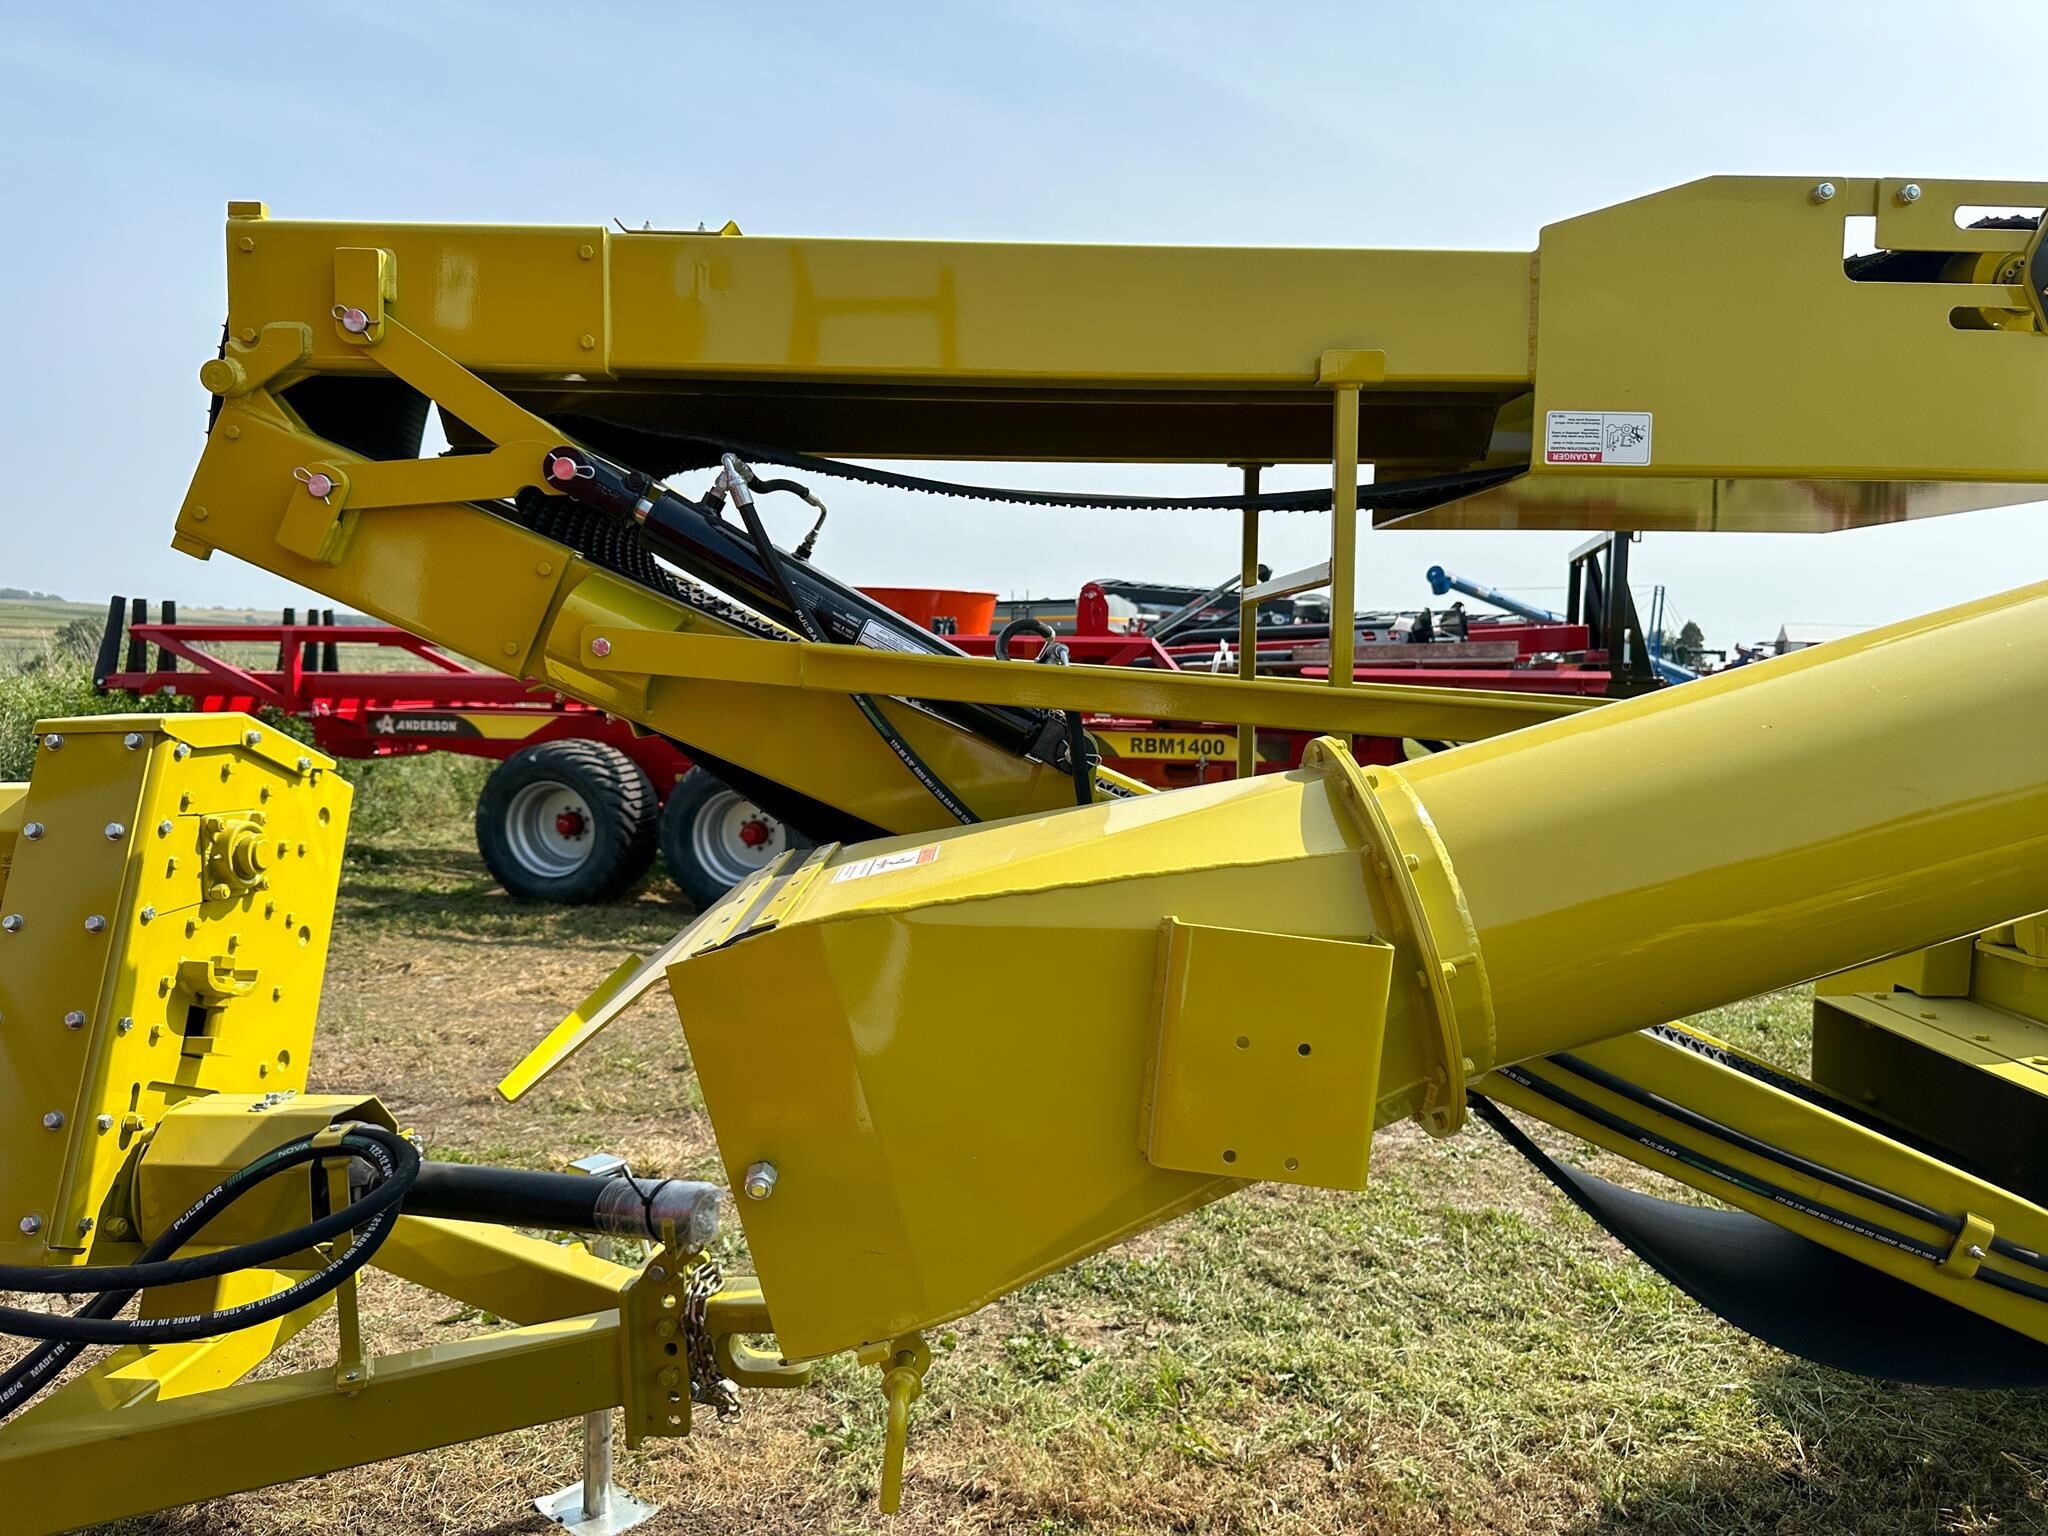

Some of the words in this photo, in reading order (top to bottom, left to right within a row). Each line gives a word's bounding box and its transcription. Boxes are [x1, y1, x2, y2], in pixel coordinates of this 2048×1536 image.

[1552, 452, 1587, 460] DANGER
[395, 720, 457, 731] ANDERSON
[1130, 737, 1224, 755] RBM1400
[278, 1143, 309, 1158] NOVA
[1640, 1137, 1677, 1156] PULSAR
[369, 1144, 389, 1165] 122-12
[173, 1185, 223, 1230] PULSAR
[368, 1217, 382, 1232] 215
[355, 1232, 371, 1247] BAR
[343, 1247, 357, 1260] WP
[327, 1259, 343, 1272] SAE
[288, 1271, 326, 1295] 100R2AT
[259, 1292, 286, 1307] MSHA
[213, 1303, 255, 1319] IC-188/4
[129, 1319, 154, 1328] ITALY
[157, 1318, 170, 1327] IN
[172, 1315, 201, 1326] MADE
[30, 1353, 54, 1377] MADE
[53, 1343, 66, 1356] IN
